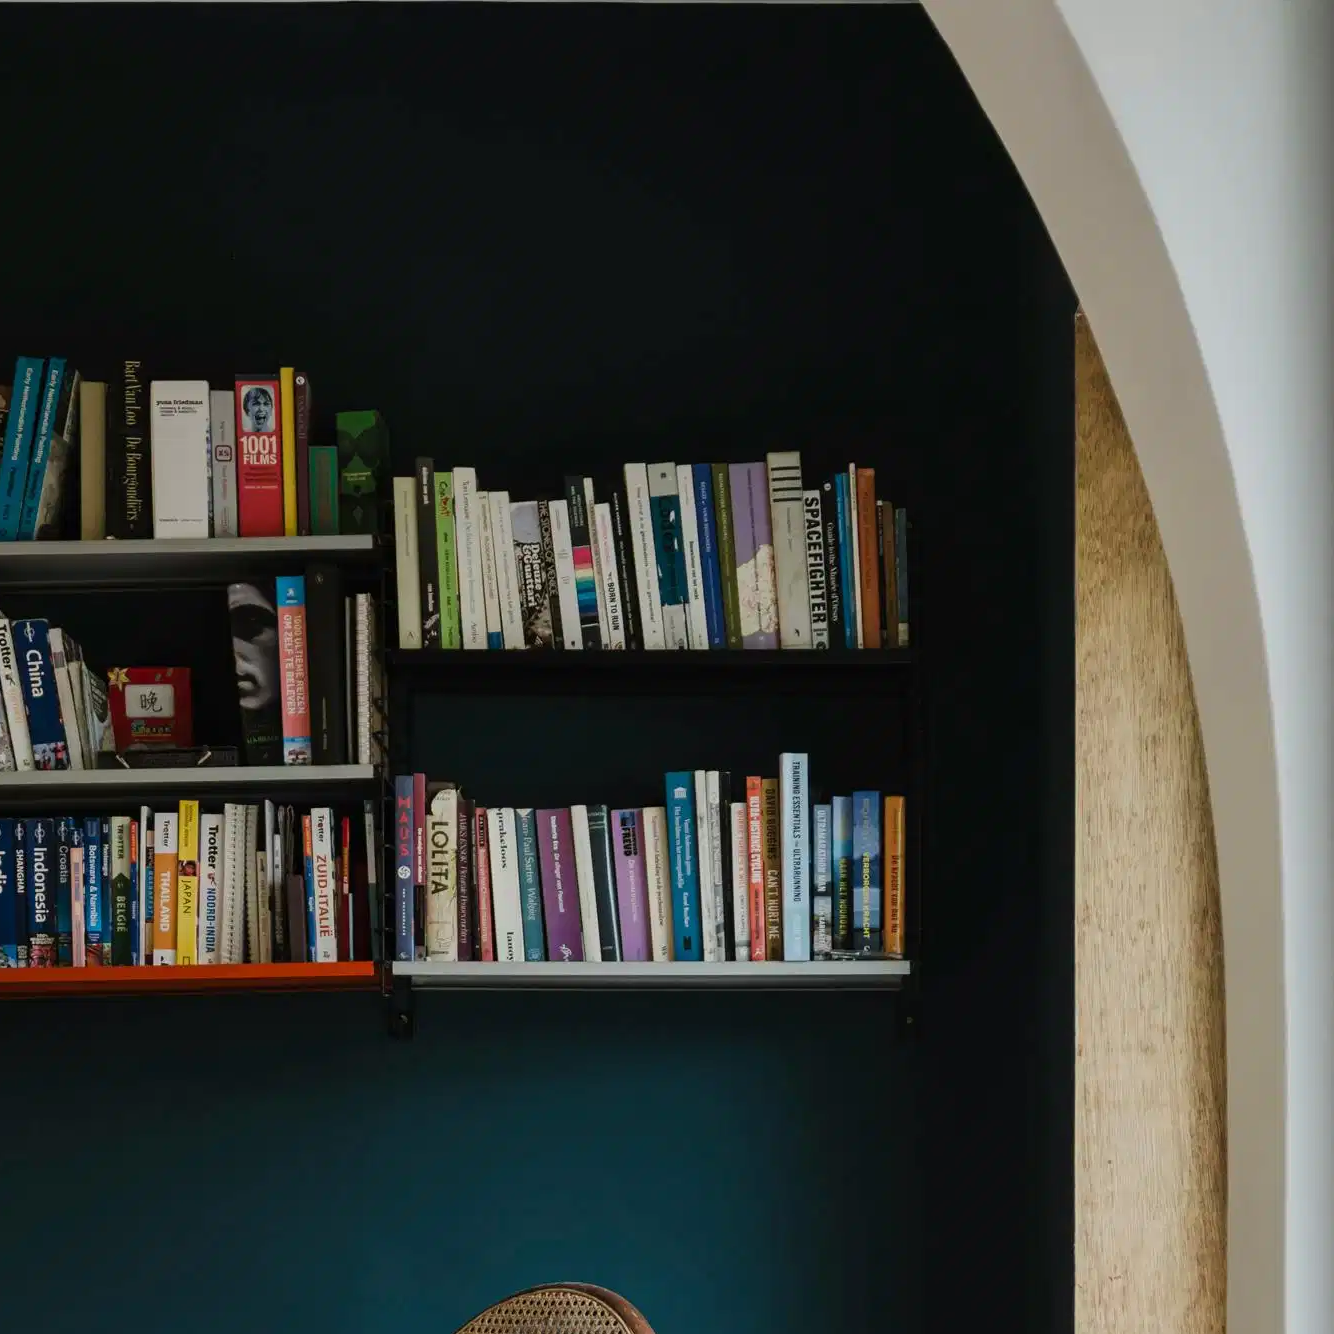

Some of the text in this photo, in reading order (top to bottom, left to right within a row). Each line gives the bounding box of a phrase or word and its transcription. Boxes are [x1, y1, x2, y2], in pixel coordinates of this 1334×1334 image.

[122, 360, 144, 520] Bart Van Loo De Bourgondiërs
[240, 436, 277, 454] 1001
[243, 454, 277, 465] FILMS
[538, 500, 548, 517] THE
[531, 544, 543, 590] Deleuze
[545, 550, 554, 562] OF
[804, 498, 827, 624] SPACEFIGHTER
[548, 566, 557, 597] VENICE
[608, 582, 617, 602] BORN
[610, 604, 618, 613] TO
[25, 649, 45, 698] China
[283, 614, 296, 714] OM ZELF TE BELEVEN
[139, 691, 163, 713] 晚
[398, 795, 411, 856] MAUS
[622, 827, 633, 857] FREUD
[792, 761, 802, 902] TRAINING ESSENTIALS ULTRARUNNING
[59, 845, 70, 884] Croatia
[431, 821, 449, 895] LOLITA
[817, 809, 827, 892] ULTRAMARATHON MAN
[15, 849, 25, 894] SHANGHAI
[33, 847, 50, 924] Indonesia
[88, 844, 99, 927] Botswana & Namibia
[159, 820, 171, 932] Trotter THAILAND
[524, 856, 536, 883] Sartre
[750, 854, 762, 884] CYCLING
[767, 869, 779, 897] CAN'T
[182, 880, 192, 915] JAPAN
[205, 825, 220, 953] Trotter NOORD-INDIA
[316, 855, 332, 938] ZUID-ITALIË
[526, 887, 539, 920] Walging
[116, 895, 129, 932] BELGIË
[768, 898, 779, 923] HURT
[862, 905, 871, 939] KRACHT
[768, 925, 780, 940] ME
